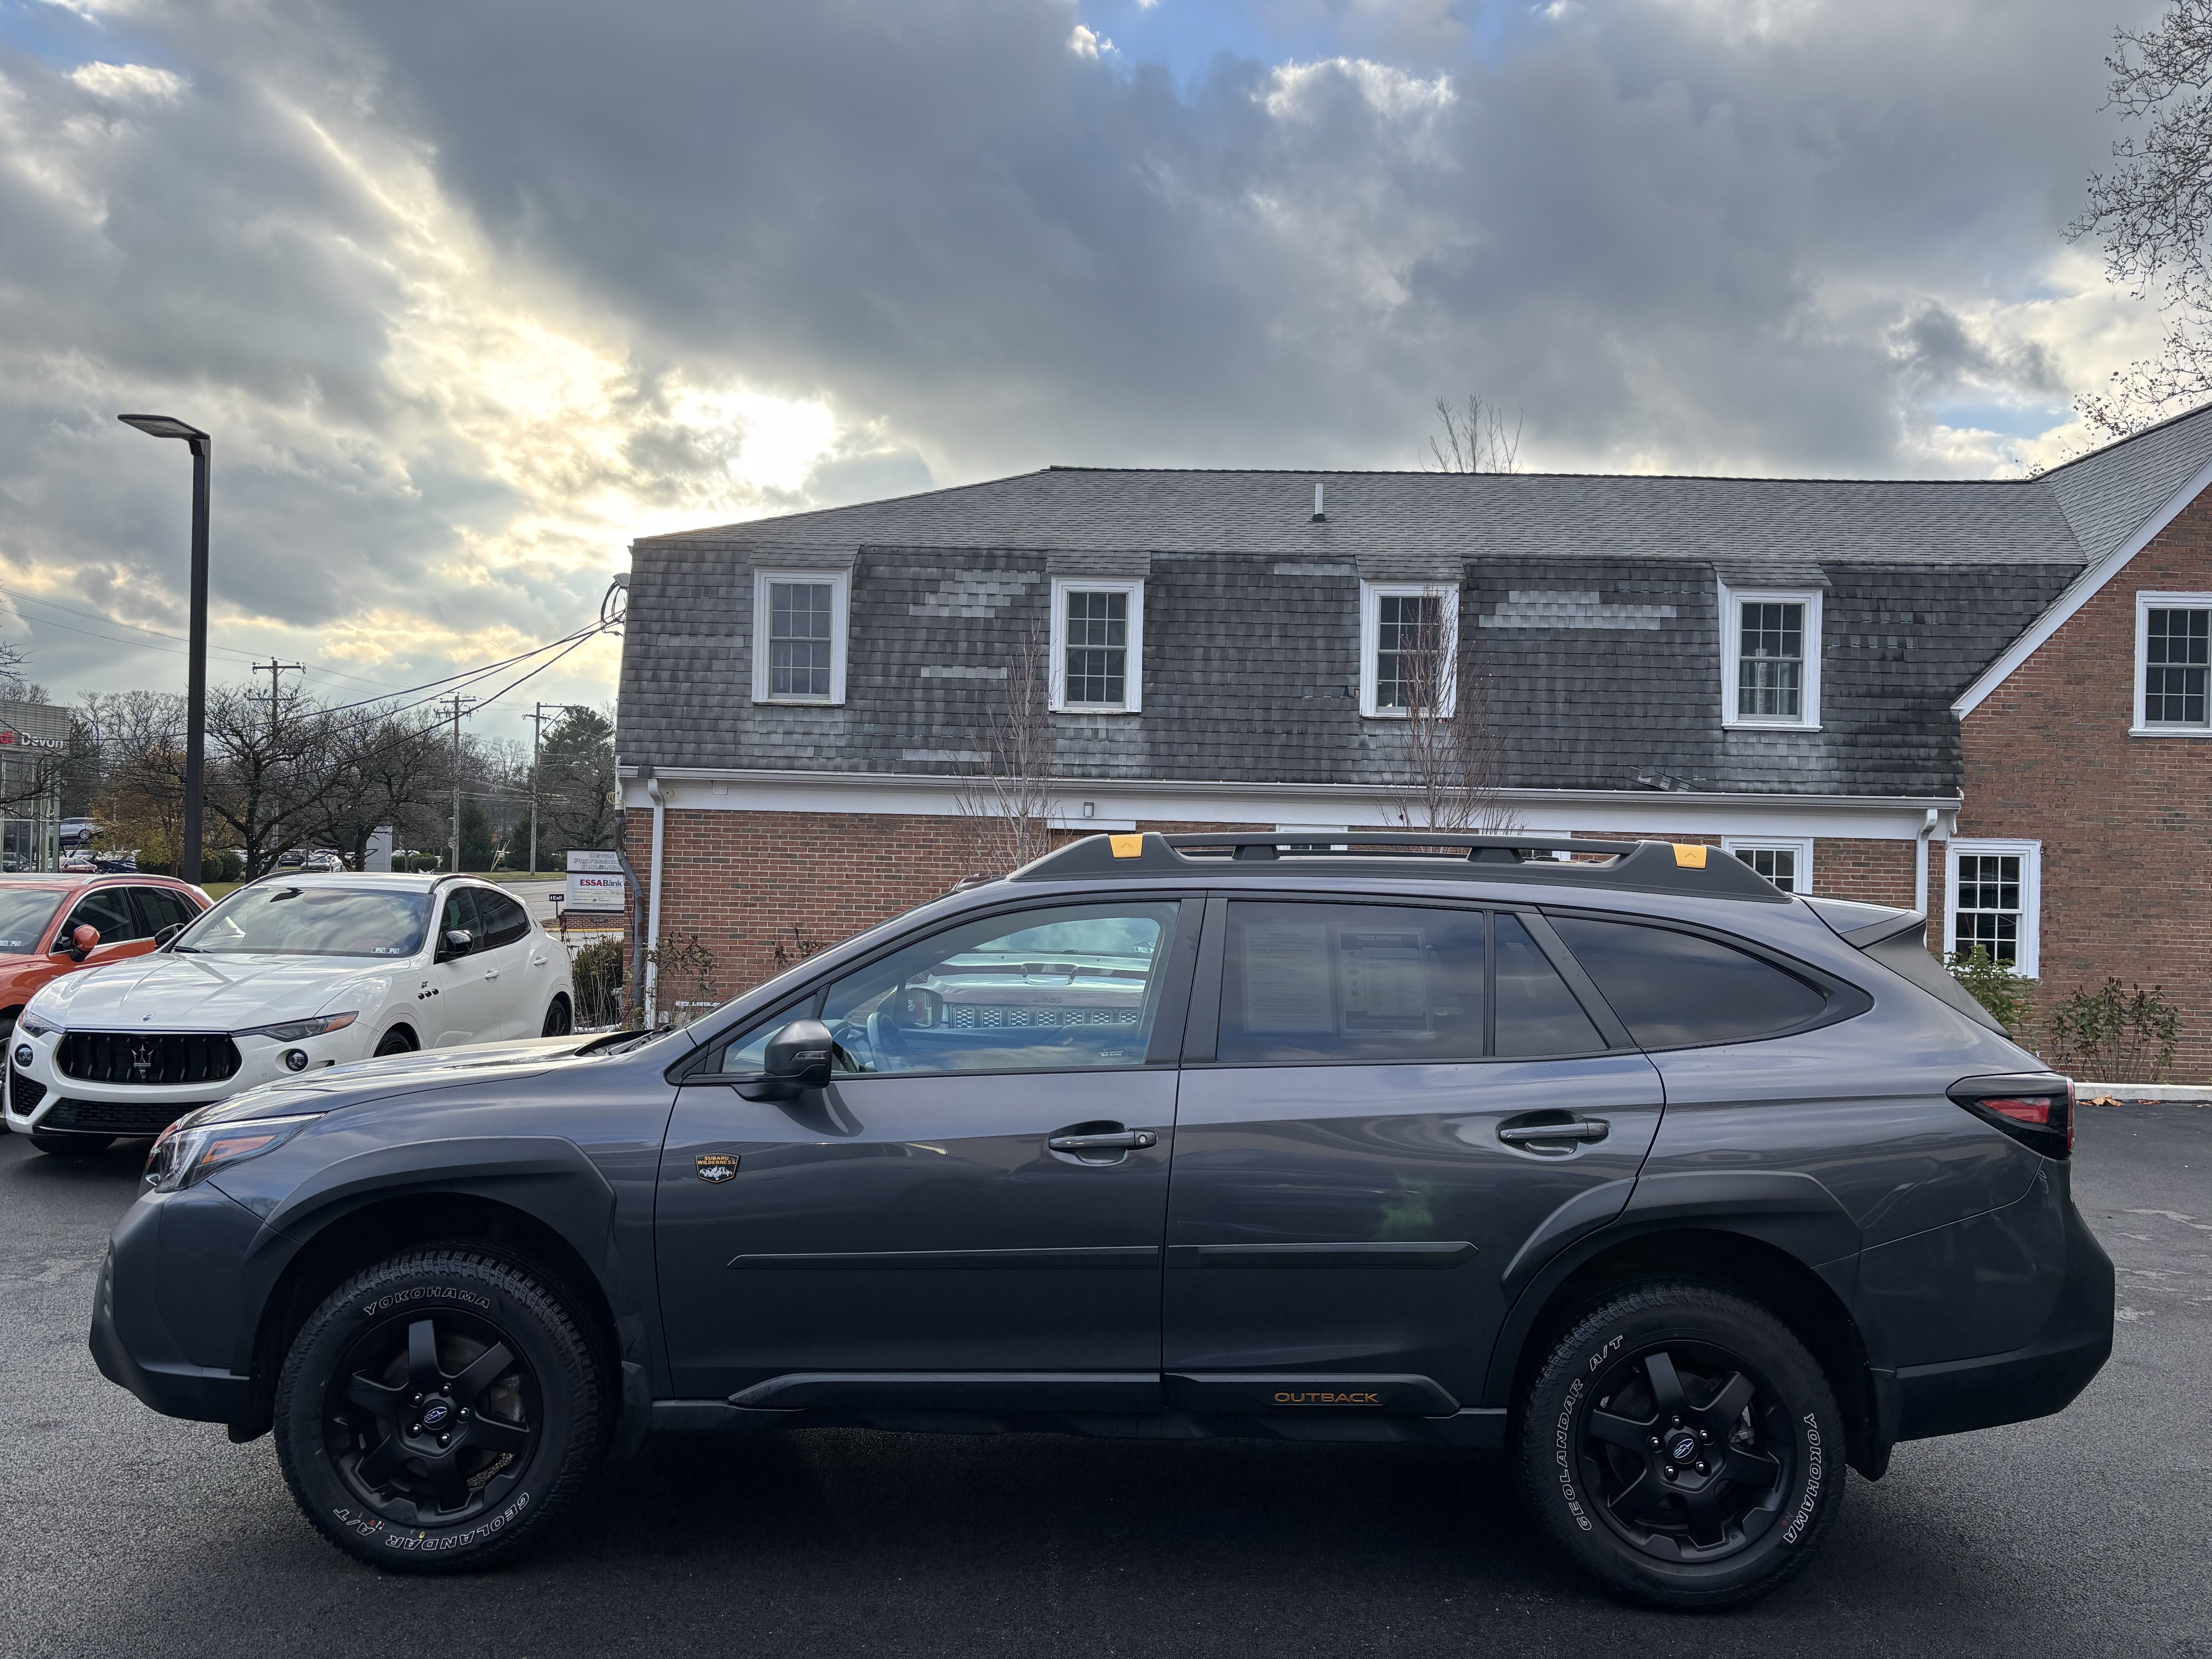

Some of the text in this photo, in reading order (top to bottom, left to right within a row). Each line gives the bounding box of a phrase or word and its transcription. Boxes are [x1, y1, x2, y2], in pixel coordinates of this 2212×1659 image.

[22, 732, 64, 748] Devon
[363, 1287, 490, 1316] YOKOHAMA
[1274, 1393, 1379, 1403] OUTBACK
[1556, 1335, 1623, 1531] GEOLANDAR A/T
[1783, 1412, 1822, 1544] YOKOHAMA
[333, 1492, 530, 1551] GEOLANDAR A/T
